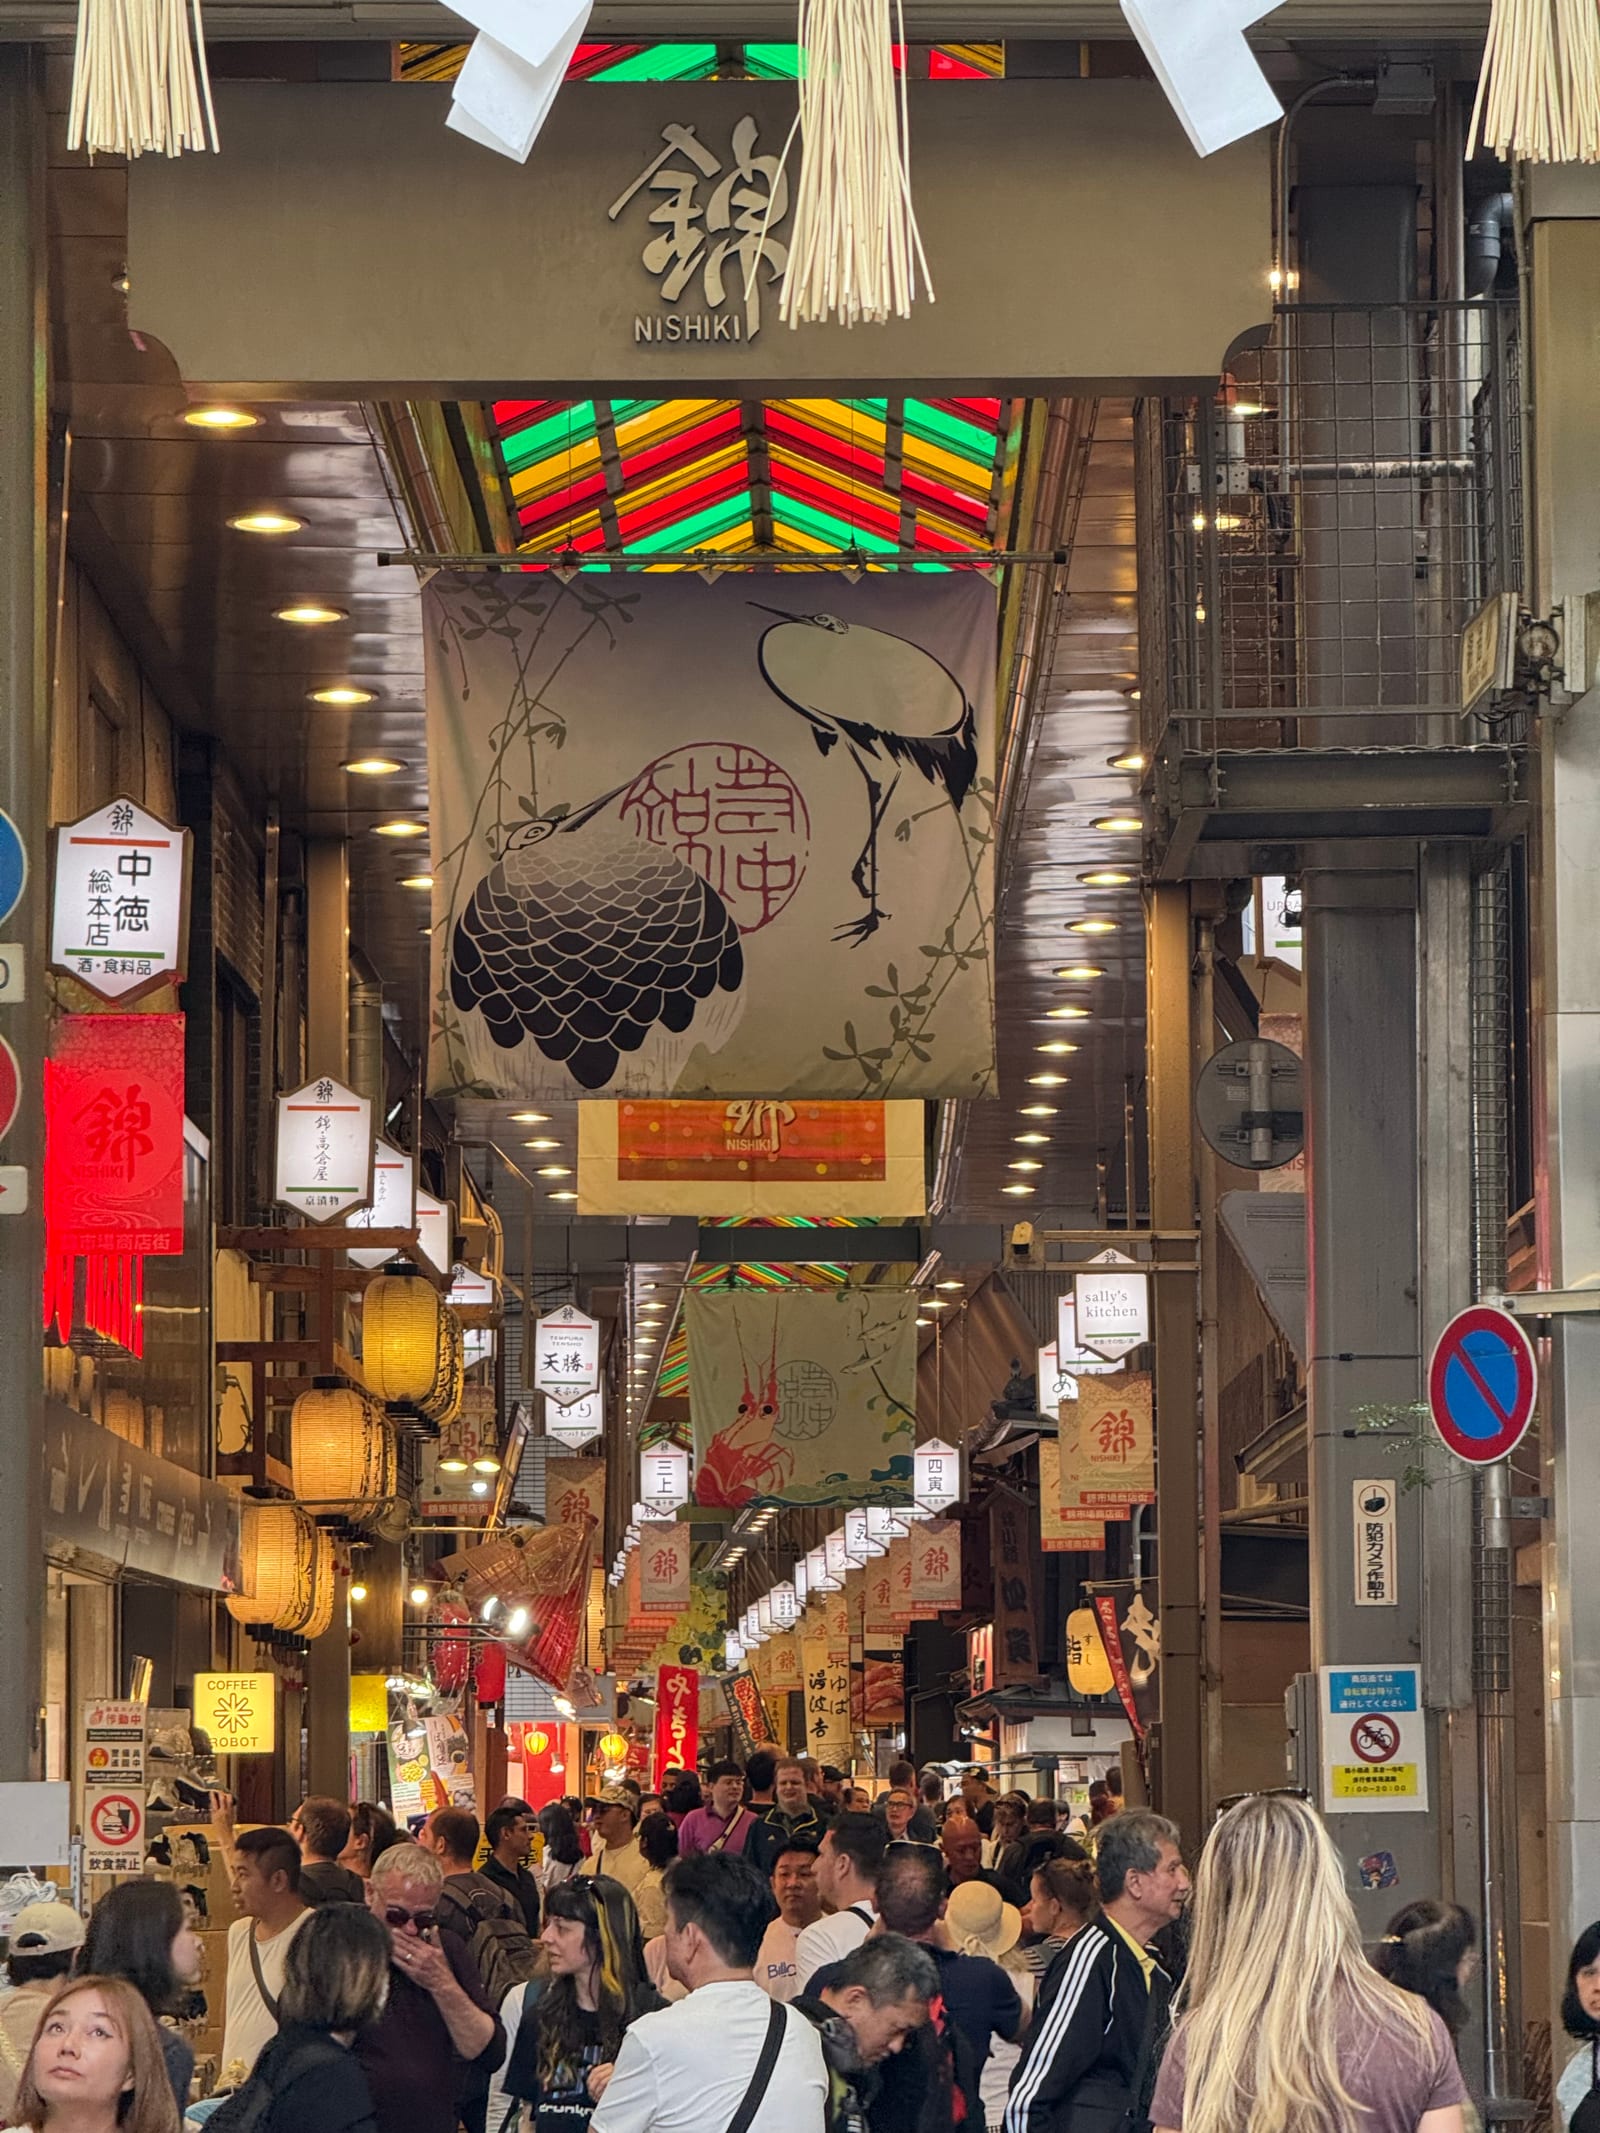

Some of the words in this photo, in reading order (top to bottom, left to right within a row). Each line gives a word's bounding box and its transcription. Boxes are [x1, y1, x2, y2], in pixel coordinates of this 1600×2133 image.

[607, 114, 790, 341] 錦
[634, 314, 742, 342] NISHIKI
[107, 804, 134, 836] 錦
[113, 849, 152, 932] 中徳
[85, 869, 113, 946] 総本店
[77, 957, 152, 976] 酒・食料品
[71, 1083, 155, 1183] 錦
[725, 1139, 772, 1152] NISHIKI
[1084, 1289, 1128, 1305] sally's
[1085, 1305, 1138, 1319] kitchen
[553, 1386, 581, 1397] 天ぷら
[1090, 1408, 1137, 1465] 錦
[1090, 1454, 1121, 1463] NISHIKI
[656, 1459, 673, 1494] 三上
[928, 1458, 943, 1492] 四寅
[648, 1547, 679, 1585] 錦
[918, 1545, 950, 1582] 錦
[1365, 1522, 1385, 1600] 防犯カメラ作動中
[1084, 1633, 1093, 1666] すし
[207, 1679, 258, 1690] COFFEE
[212, 1736, 260, 1748] ROBOT
[88, 1857, 141, 1871] 飲食禁止
